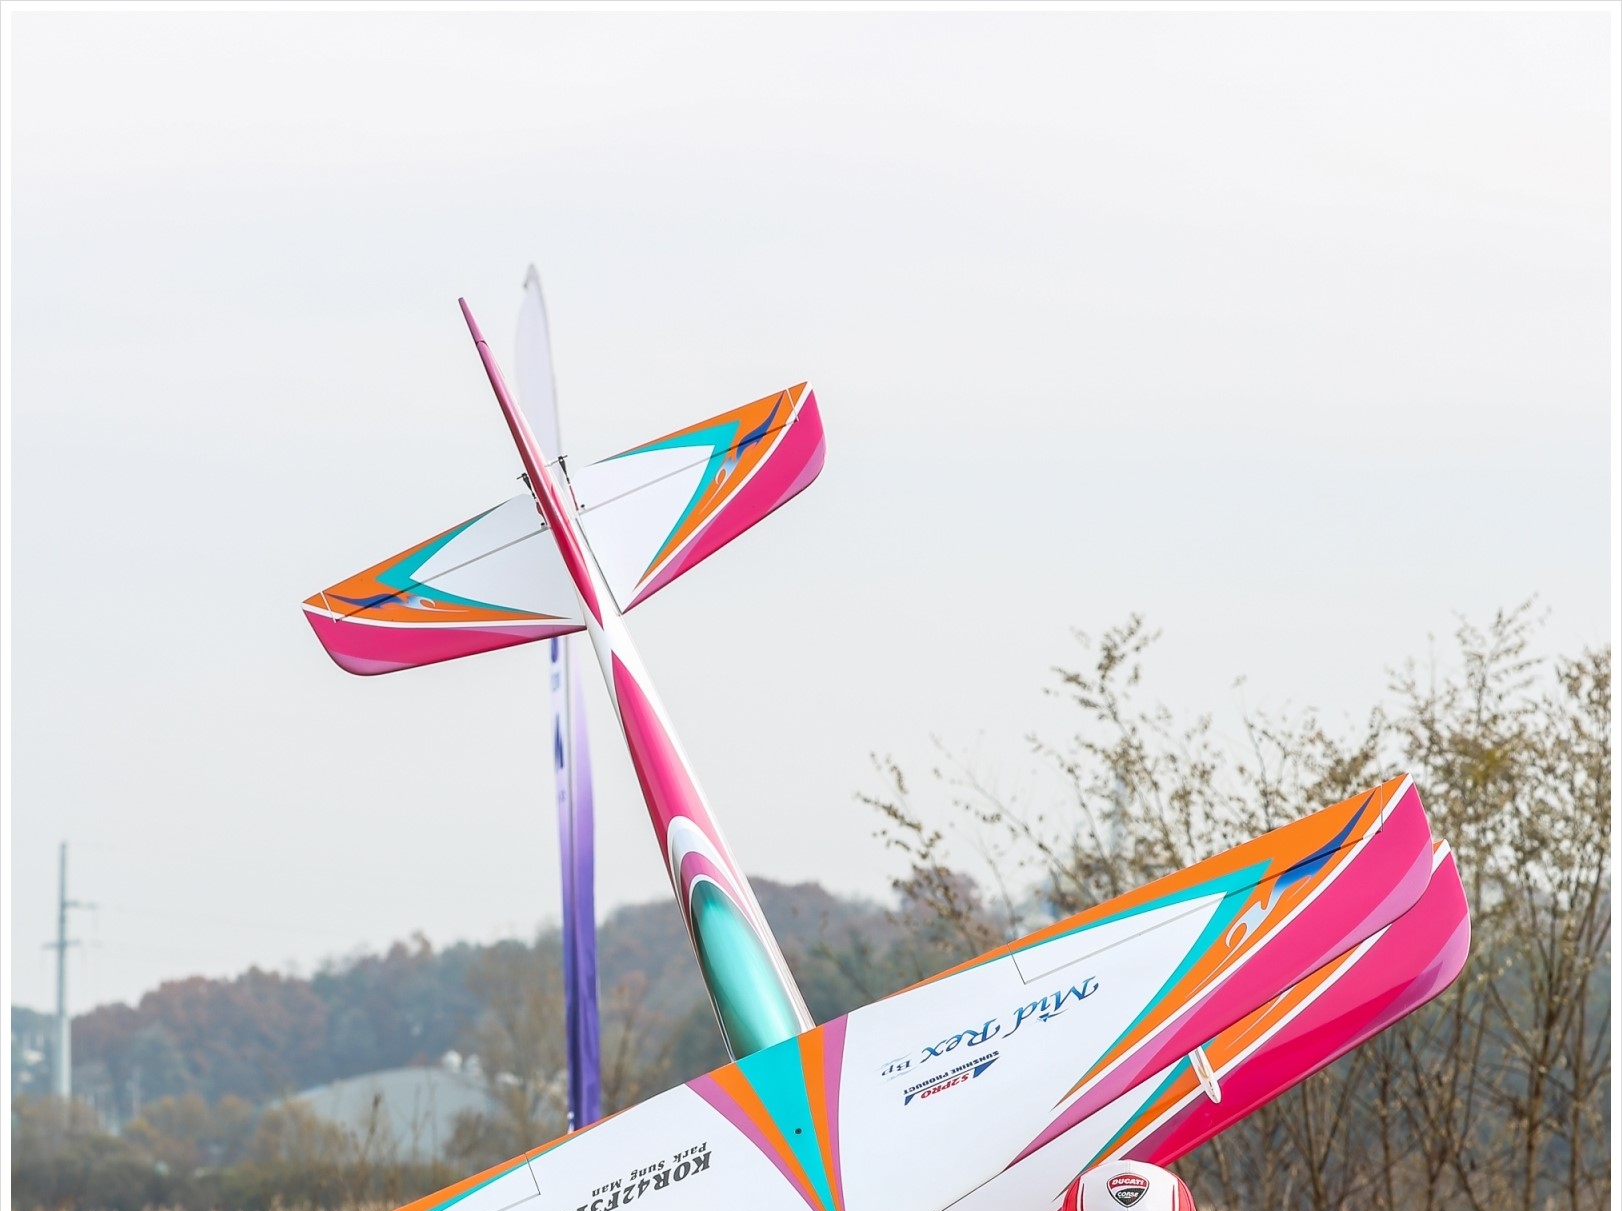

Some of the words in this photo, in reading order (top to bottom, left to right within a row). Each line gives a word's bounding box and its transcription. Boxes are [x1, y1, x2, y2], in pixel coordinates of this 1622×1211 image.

[1001, 975, 1099, 1039] Mid
[920, 1018, 1001, 1064] Rex
[949, 1050, 1000, 1076] SUNSHINE
[903, 1072, 949, 1095] PRODUCT
[672, 1141, 708, 1164] Park
[630, 1159, 666, 1181] Sung
[591, 1178, 623, 1198] Man
[1111, 1178, 1145, 1186] DUCATI
